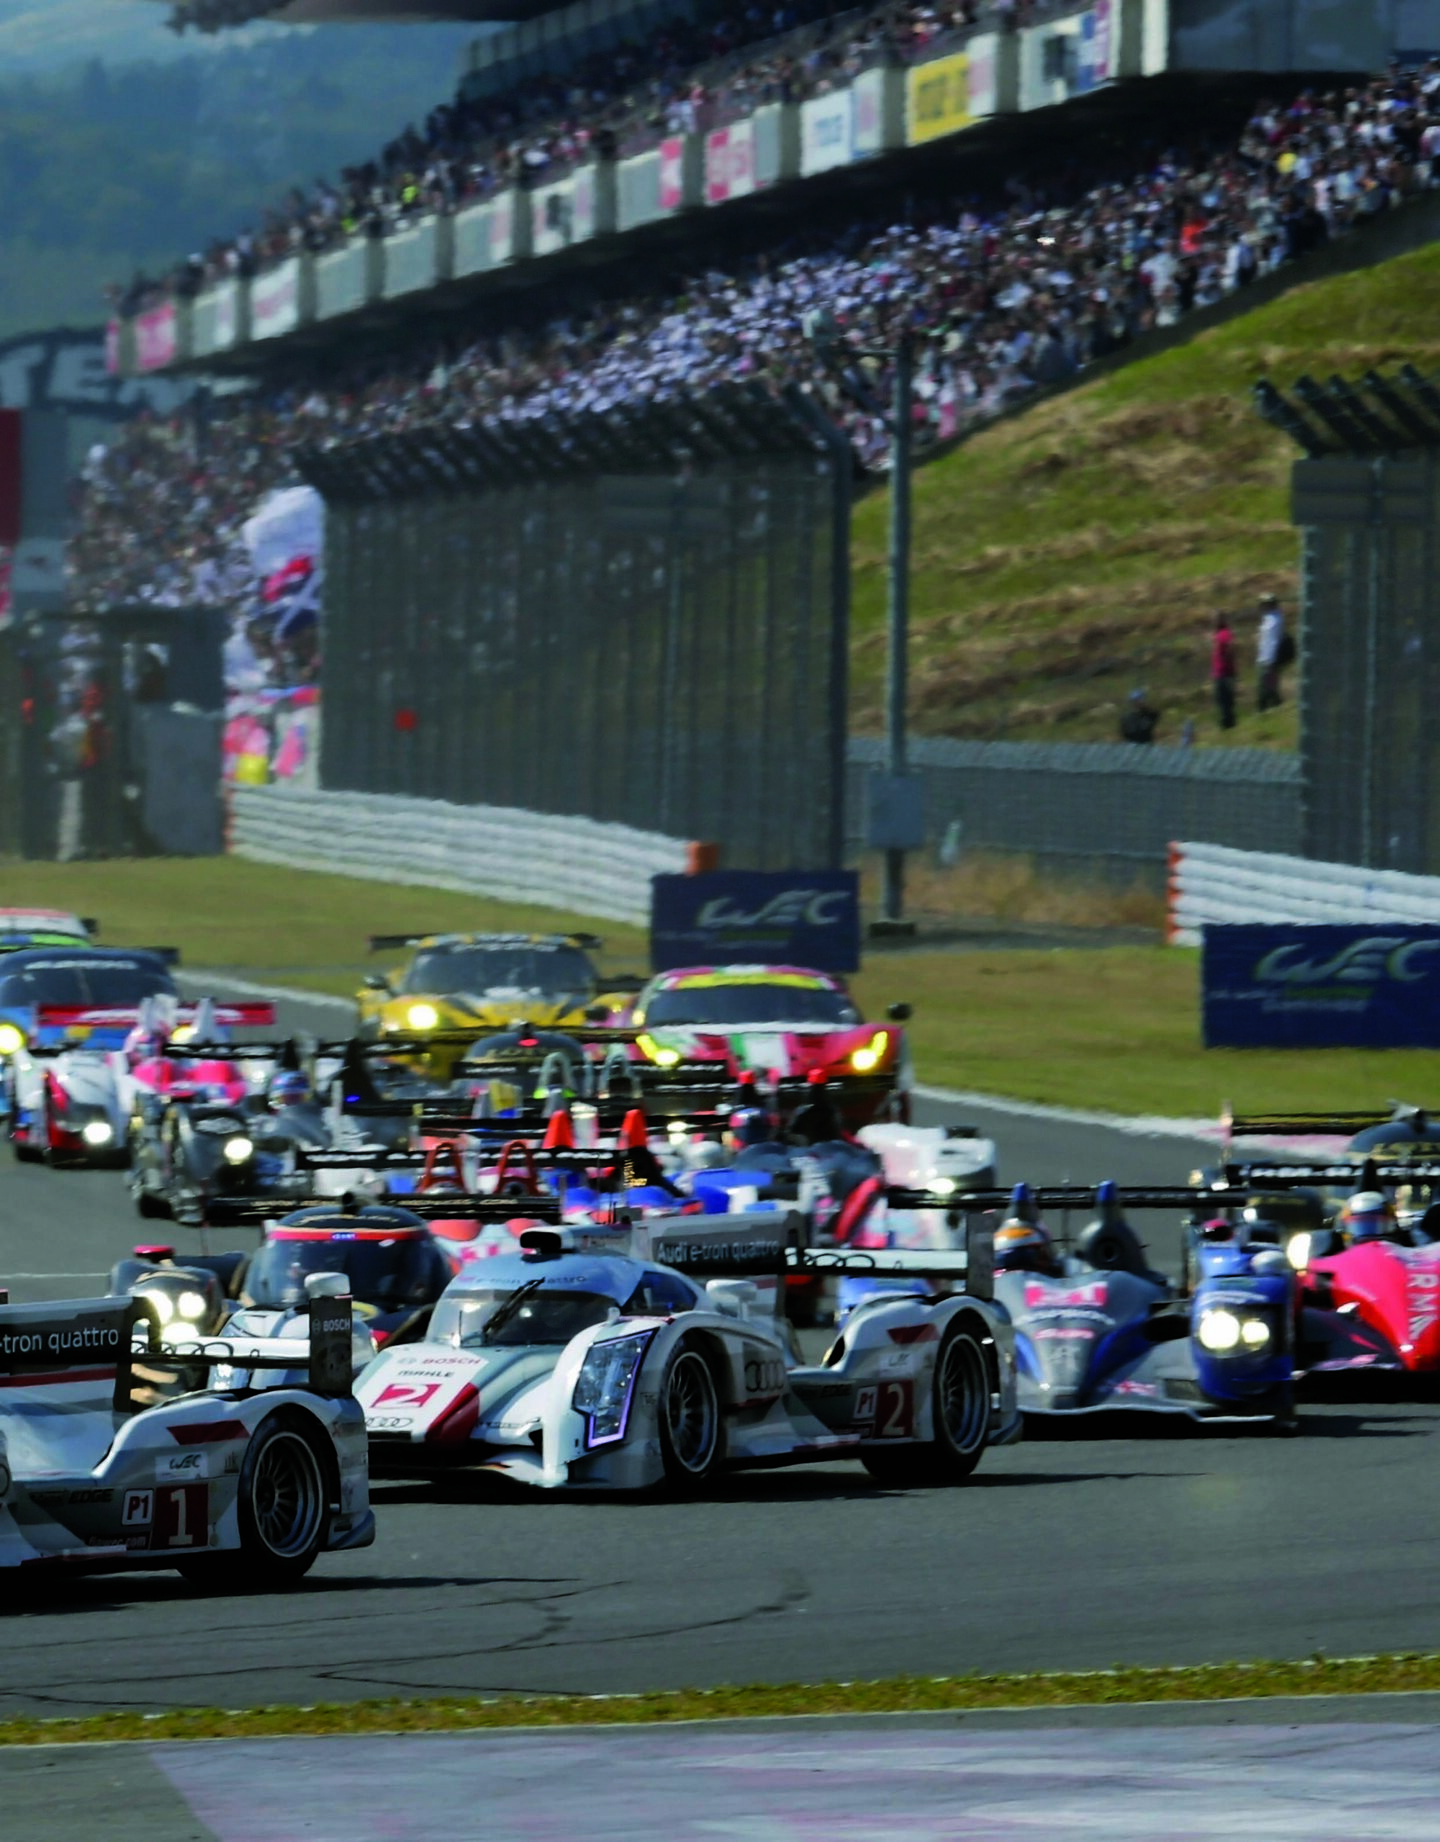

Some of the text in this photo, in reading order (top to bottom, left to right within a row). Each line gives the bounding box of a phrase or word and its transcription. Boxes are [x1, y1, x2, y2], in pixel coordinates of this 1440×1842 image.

[656, 1239, 780, 1263] Audi e-tron quattro
[322, 1317, 351, 1333] BOSCH
[48, 1327, 119, 1354] quattro
[421, 1356, 481, 1366] BOSCH
[372, 1383, 427, 1407] 2
[857, 1383, 905, 1435] P1 2
[169, 1453, 201, 1470] WEC
[126, 1488, 193, 1546] P1 1
